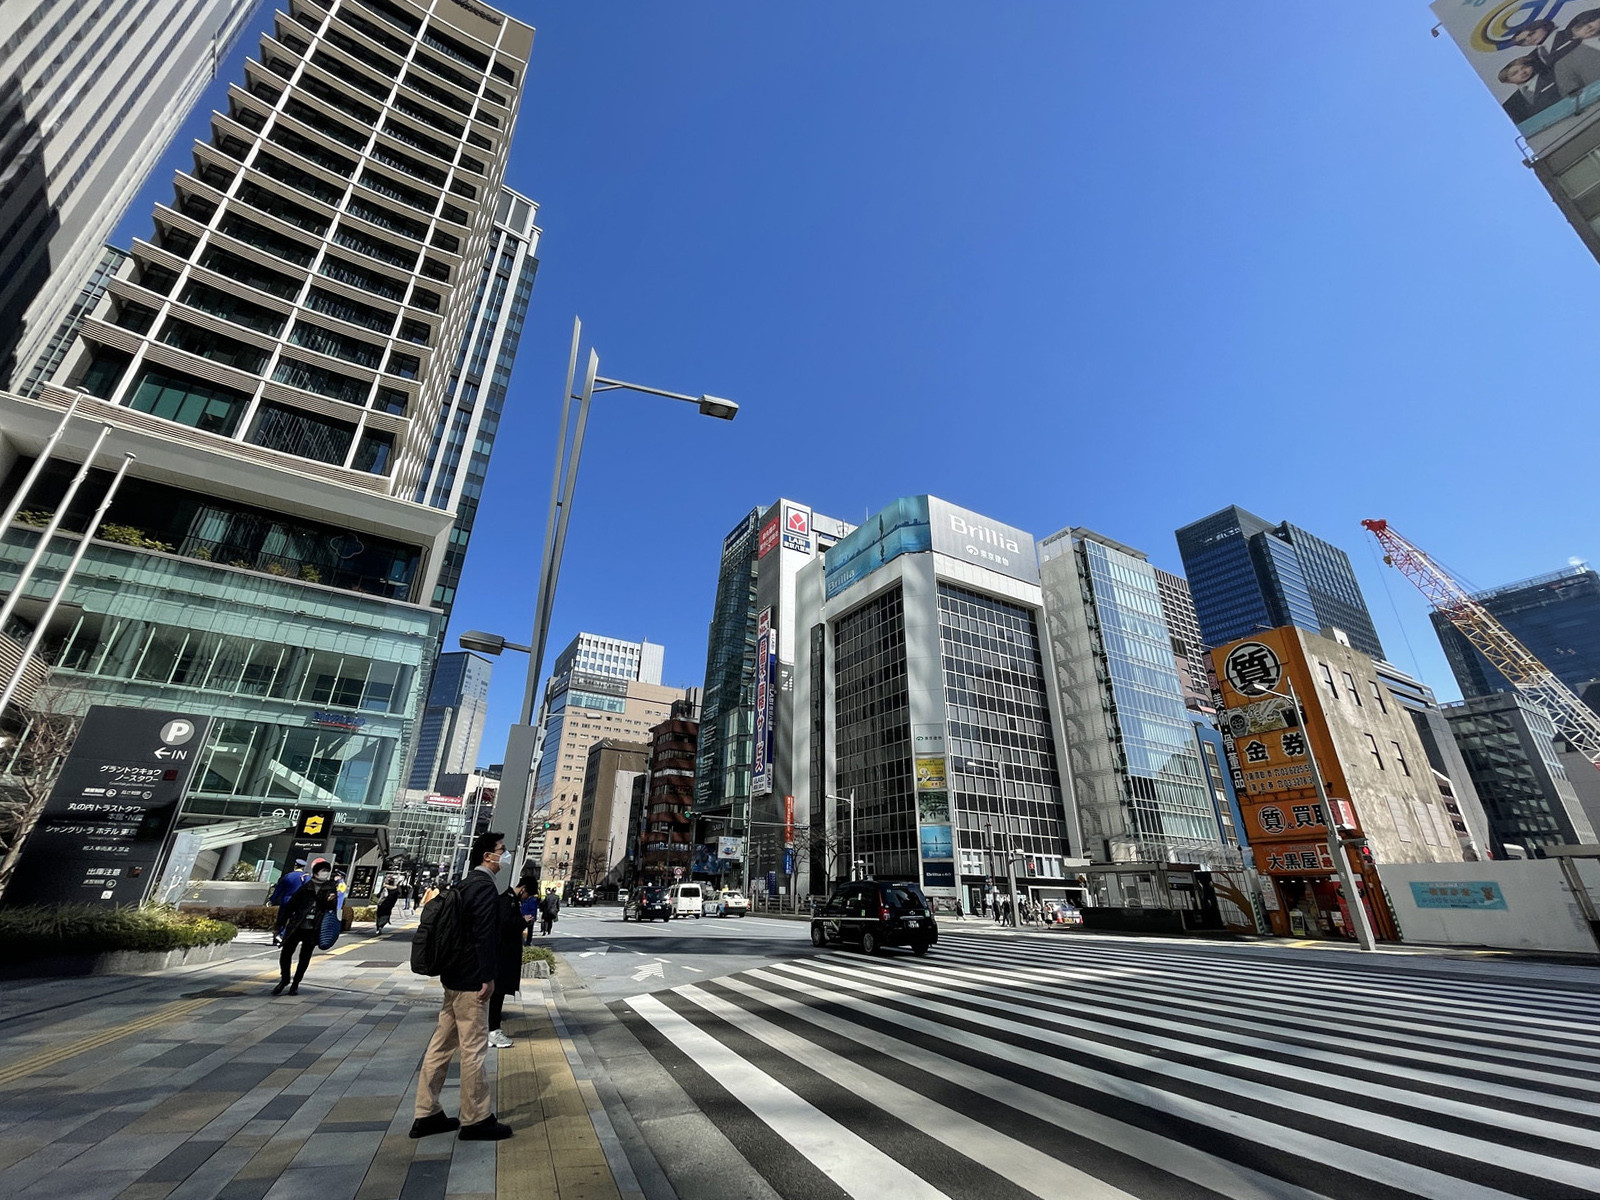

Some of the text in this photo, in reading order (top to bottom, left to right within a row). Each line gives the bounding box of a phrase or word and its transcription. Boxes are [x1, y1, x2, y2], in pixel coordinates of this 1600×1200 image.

[948, 514, 1020, 554] Brillia
[827, 569, 856, 591] Brillia
[166, 722, 190, 742] P
[171, 750, 188, 760] IN
[100, 765, 162, 776] グラントウキョウ
[115, 774, 159, 782] ノースタワー
[67, 802, 147, 812] 丸の内トラストタワー
[1261, 808, 1284, 830] 質
[44, 825, 95, 835] シャングリ・ラ
[95, 827, 120, 835] ホテル
[1267, 851, 1320, 870] 大黒屋
